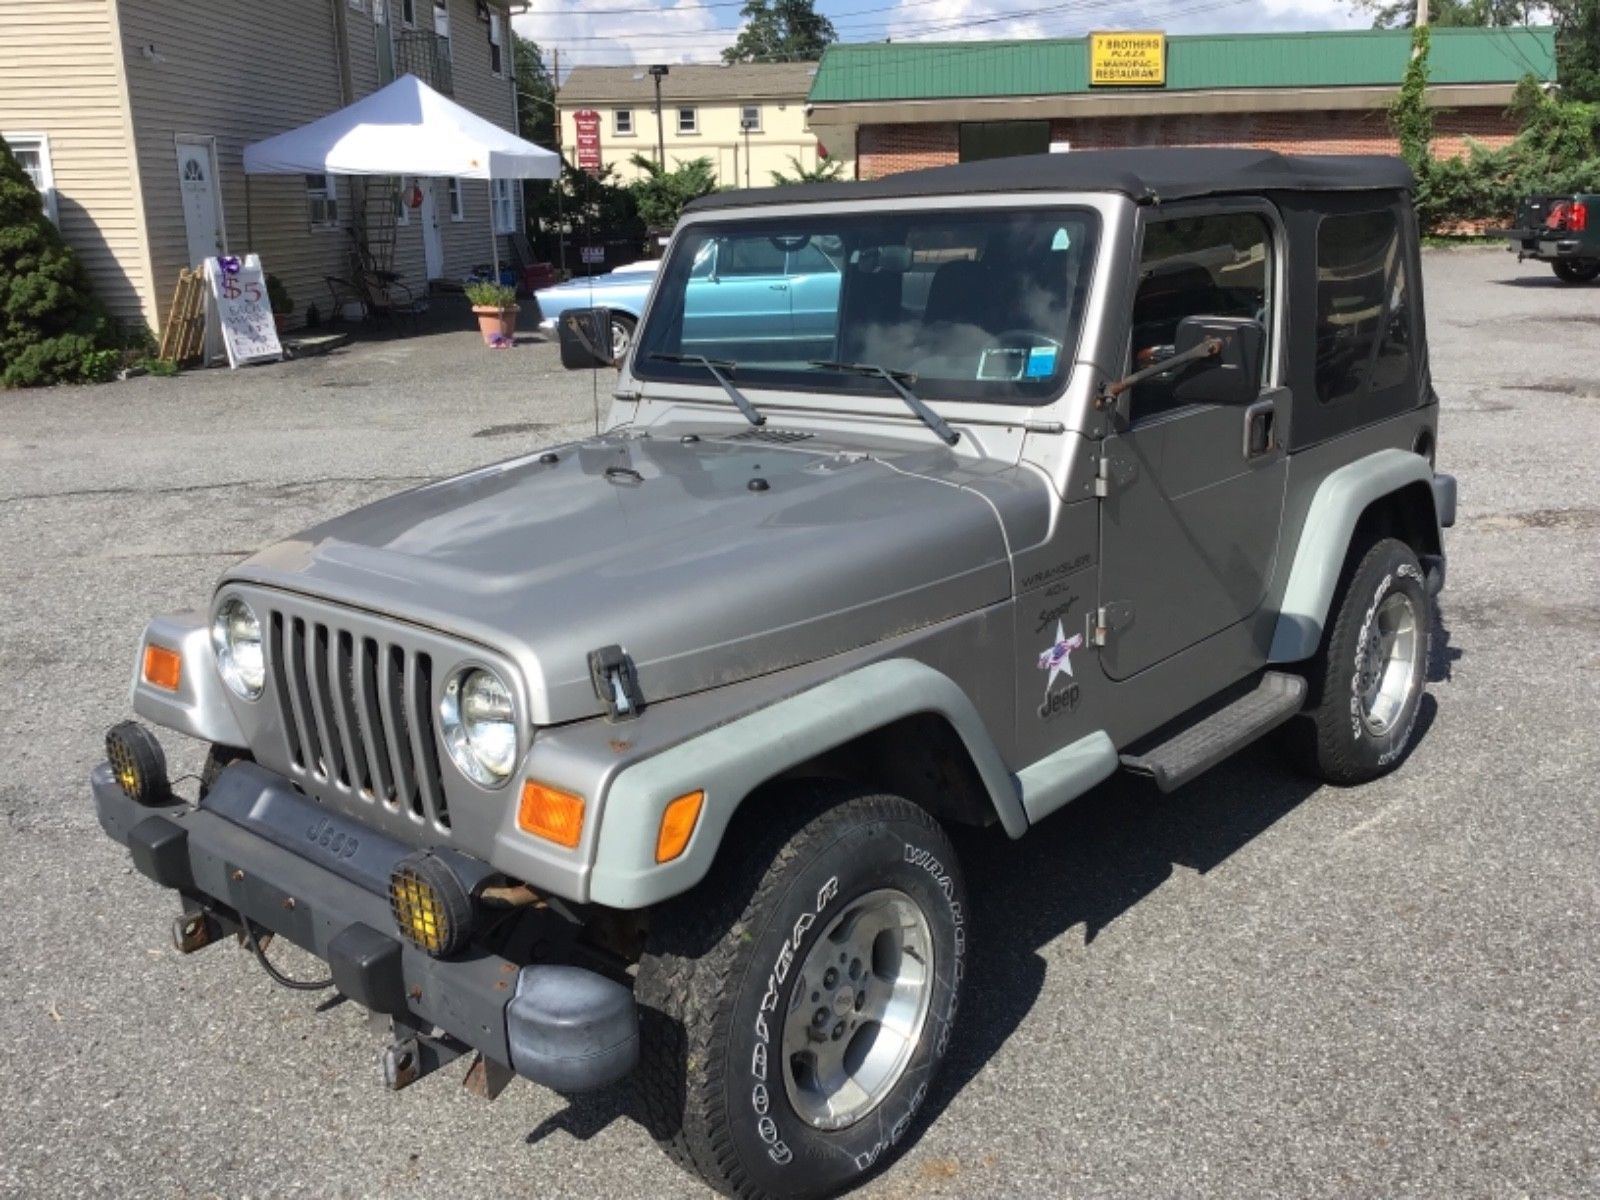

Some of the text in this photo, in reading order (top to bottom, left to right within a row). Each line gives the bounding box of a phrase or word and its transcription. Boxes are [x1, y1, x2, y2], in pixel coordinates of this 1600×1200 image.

[1106, 38, 1160, 50] BROTHERS
[1110, 50, 1146, 58] PLAZA
[1095, 69, 1160, 79] RESTAURANT
[1021, 553, 1091, 587] WRANGLER
[1038, 683, 1080, 718] Jeep
[306, 816, 360, 860] Jeep
[752, 875, 839, 1165] GOODYEAR
